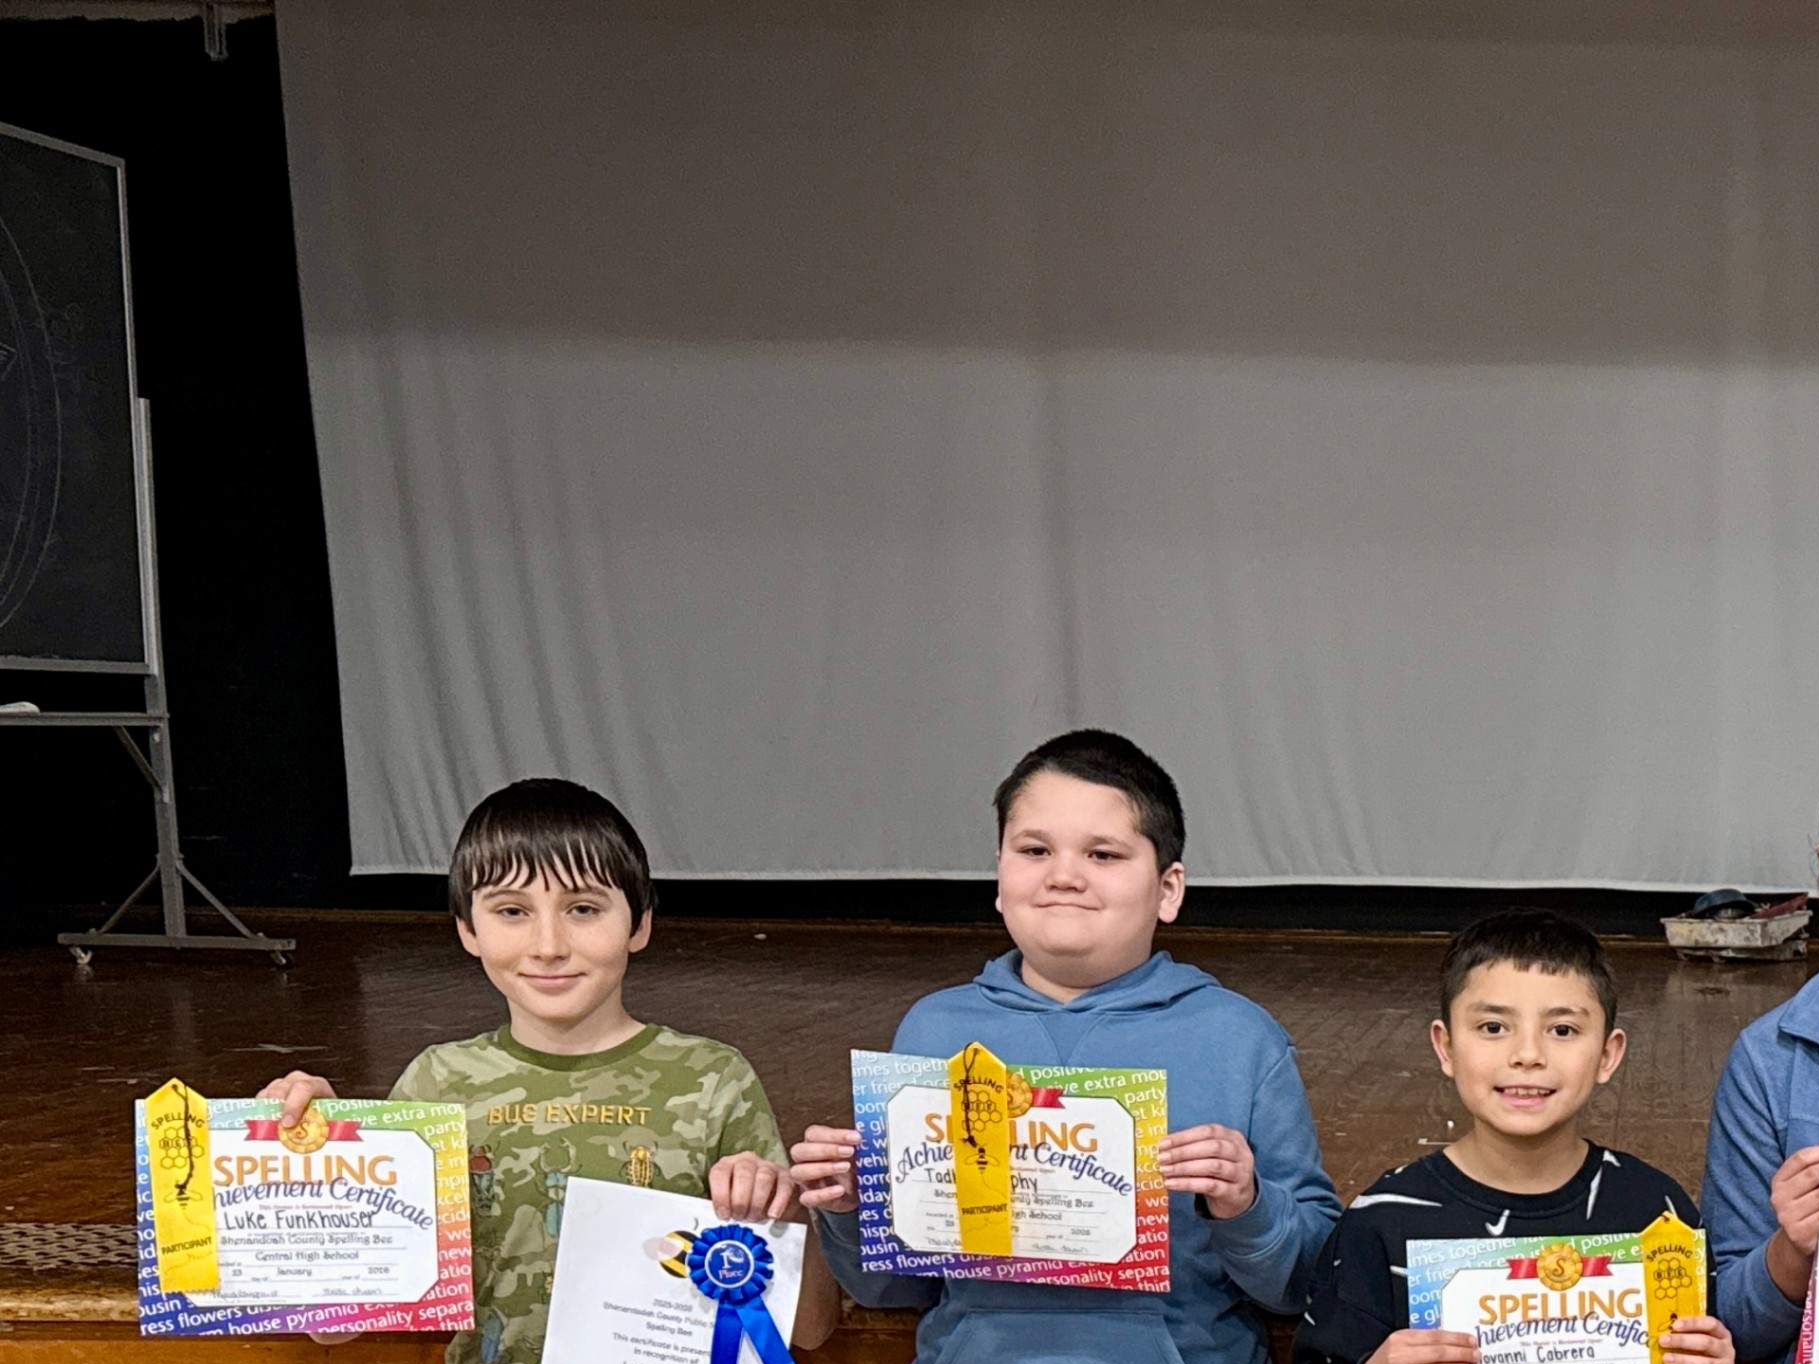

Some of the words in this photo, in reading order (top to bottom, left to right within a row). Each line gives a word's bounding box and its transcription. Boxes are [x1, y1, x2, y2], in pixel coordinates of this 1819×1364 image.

[1084, 1074, 1125, 1091] extra
[383, 1107, 426, 1127] extra
[545, 1103, 651, 1126] EXPERT
[213, 1155, 398, 1187] SPELLING
[1034, 1142, 1133, 1197] Certificate
[330, 1177, 434, 1230] Certificate
[961, 1203, 1008, 1216] PARTICIPANT
[224, 1210, 267, 1230] Luke
[275, 1209, 374, 1229] Funkhouser
[162, 1236, 212, 1255] PARTICIPANT
[1646, 1244, 1694, 1263] SPELLING
[255, 1251, 293, 1262] Central
[323, 1250, 359, 1261] School
[896, 1253, 956, 1269] flowers
[942, 1264, 992, 1280] house
[1478, 1288, 1643, 1326] SPELLING
[177, 1306, 243, 1328] flowers
[228, 1317, 282, 1335] house
[318, 1311, 415, 1334] personality
[1537, 1346, 1595, 1363] Cabrera
